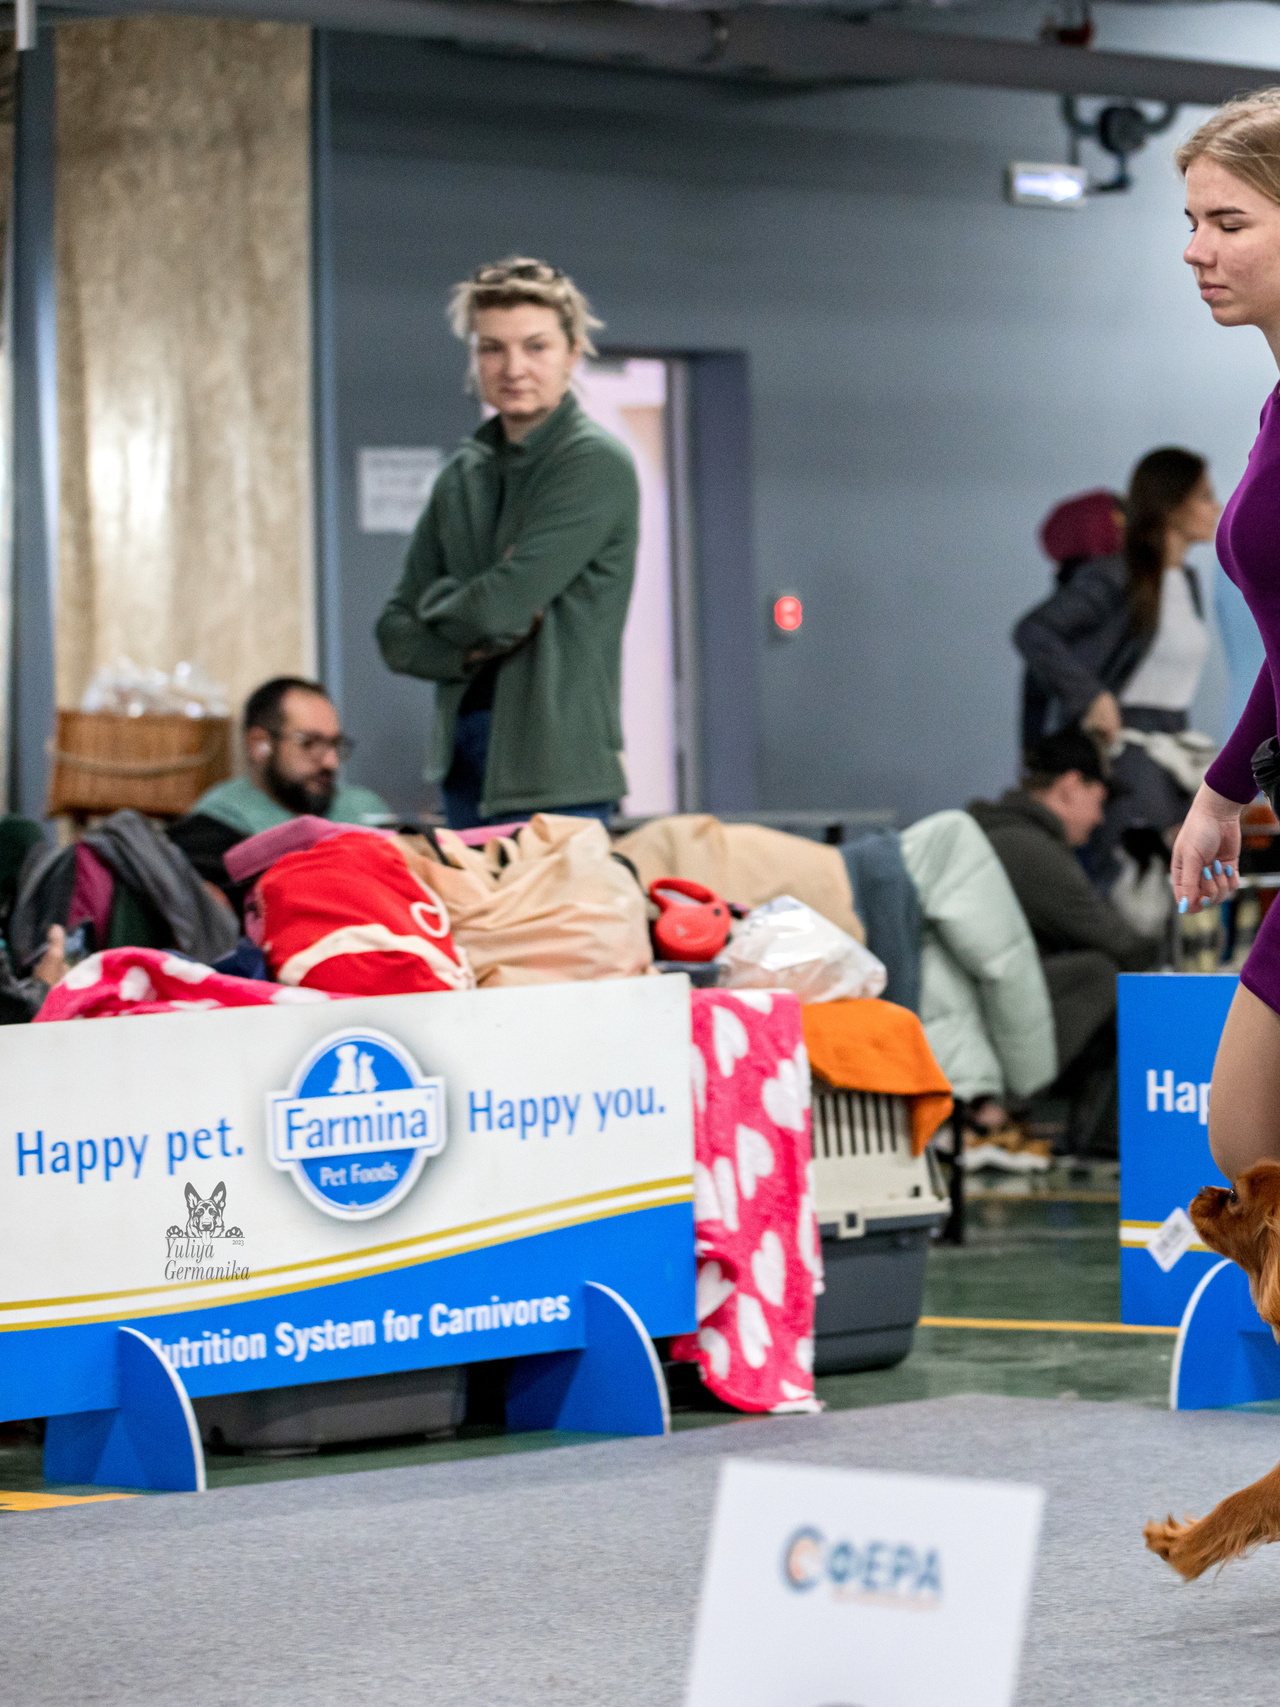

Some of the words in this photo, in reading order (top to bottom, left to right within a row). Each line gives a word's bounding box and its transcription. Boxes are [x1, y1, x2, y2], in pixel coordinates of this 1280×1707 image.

[468, 1089, 581, 1141] Happy
[593, 1086, 667, 1132] you.
[1146, 1069, 1211, 1125] Hap
[16, 1130, 149, 1184] Happy
[167, 1117, 244, 1176] pet.
[285, 1100, 428, 1151] Farmina
[319, 1167, 347, 1187] Pet
[350, 1161, 399, 1186] Foods
[275, 1318, 377, 1362] System
[382, 1309, 423, 1343] for
[429, 1294, 571, 1337] Carnivores
